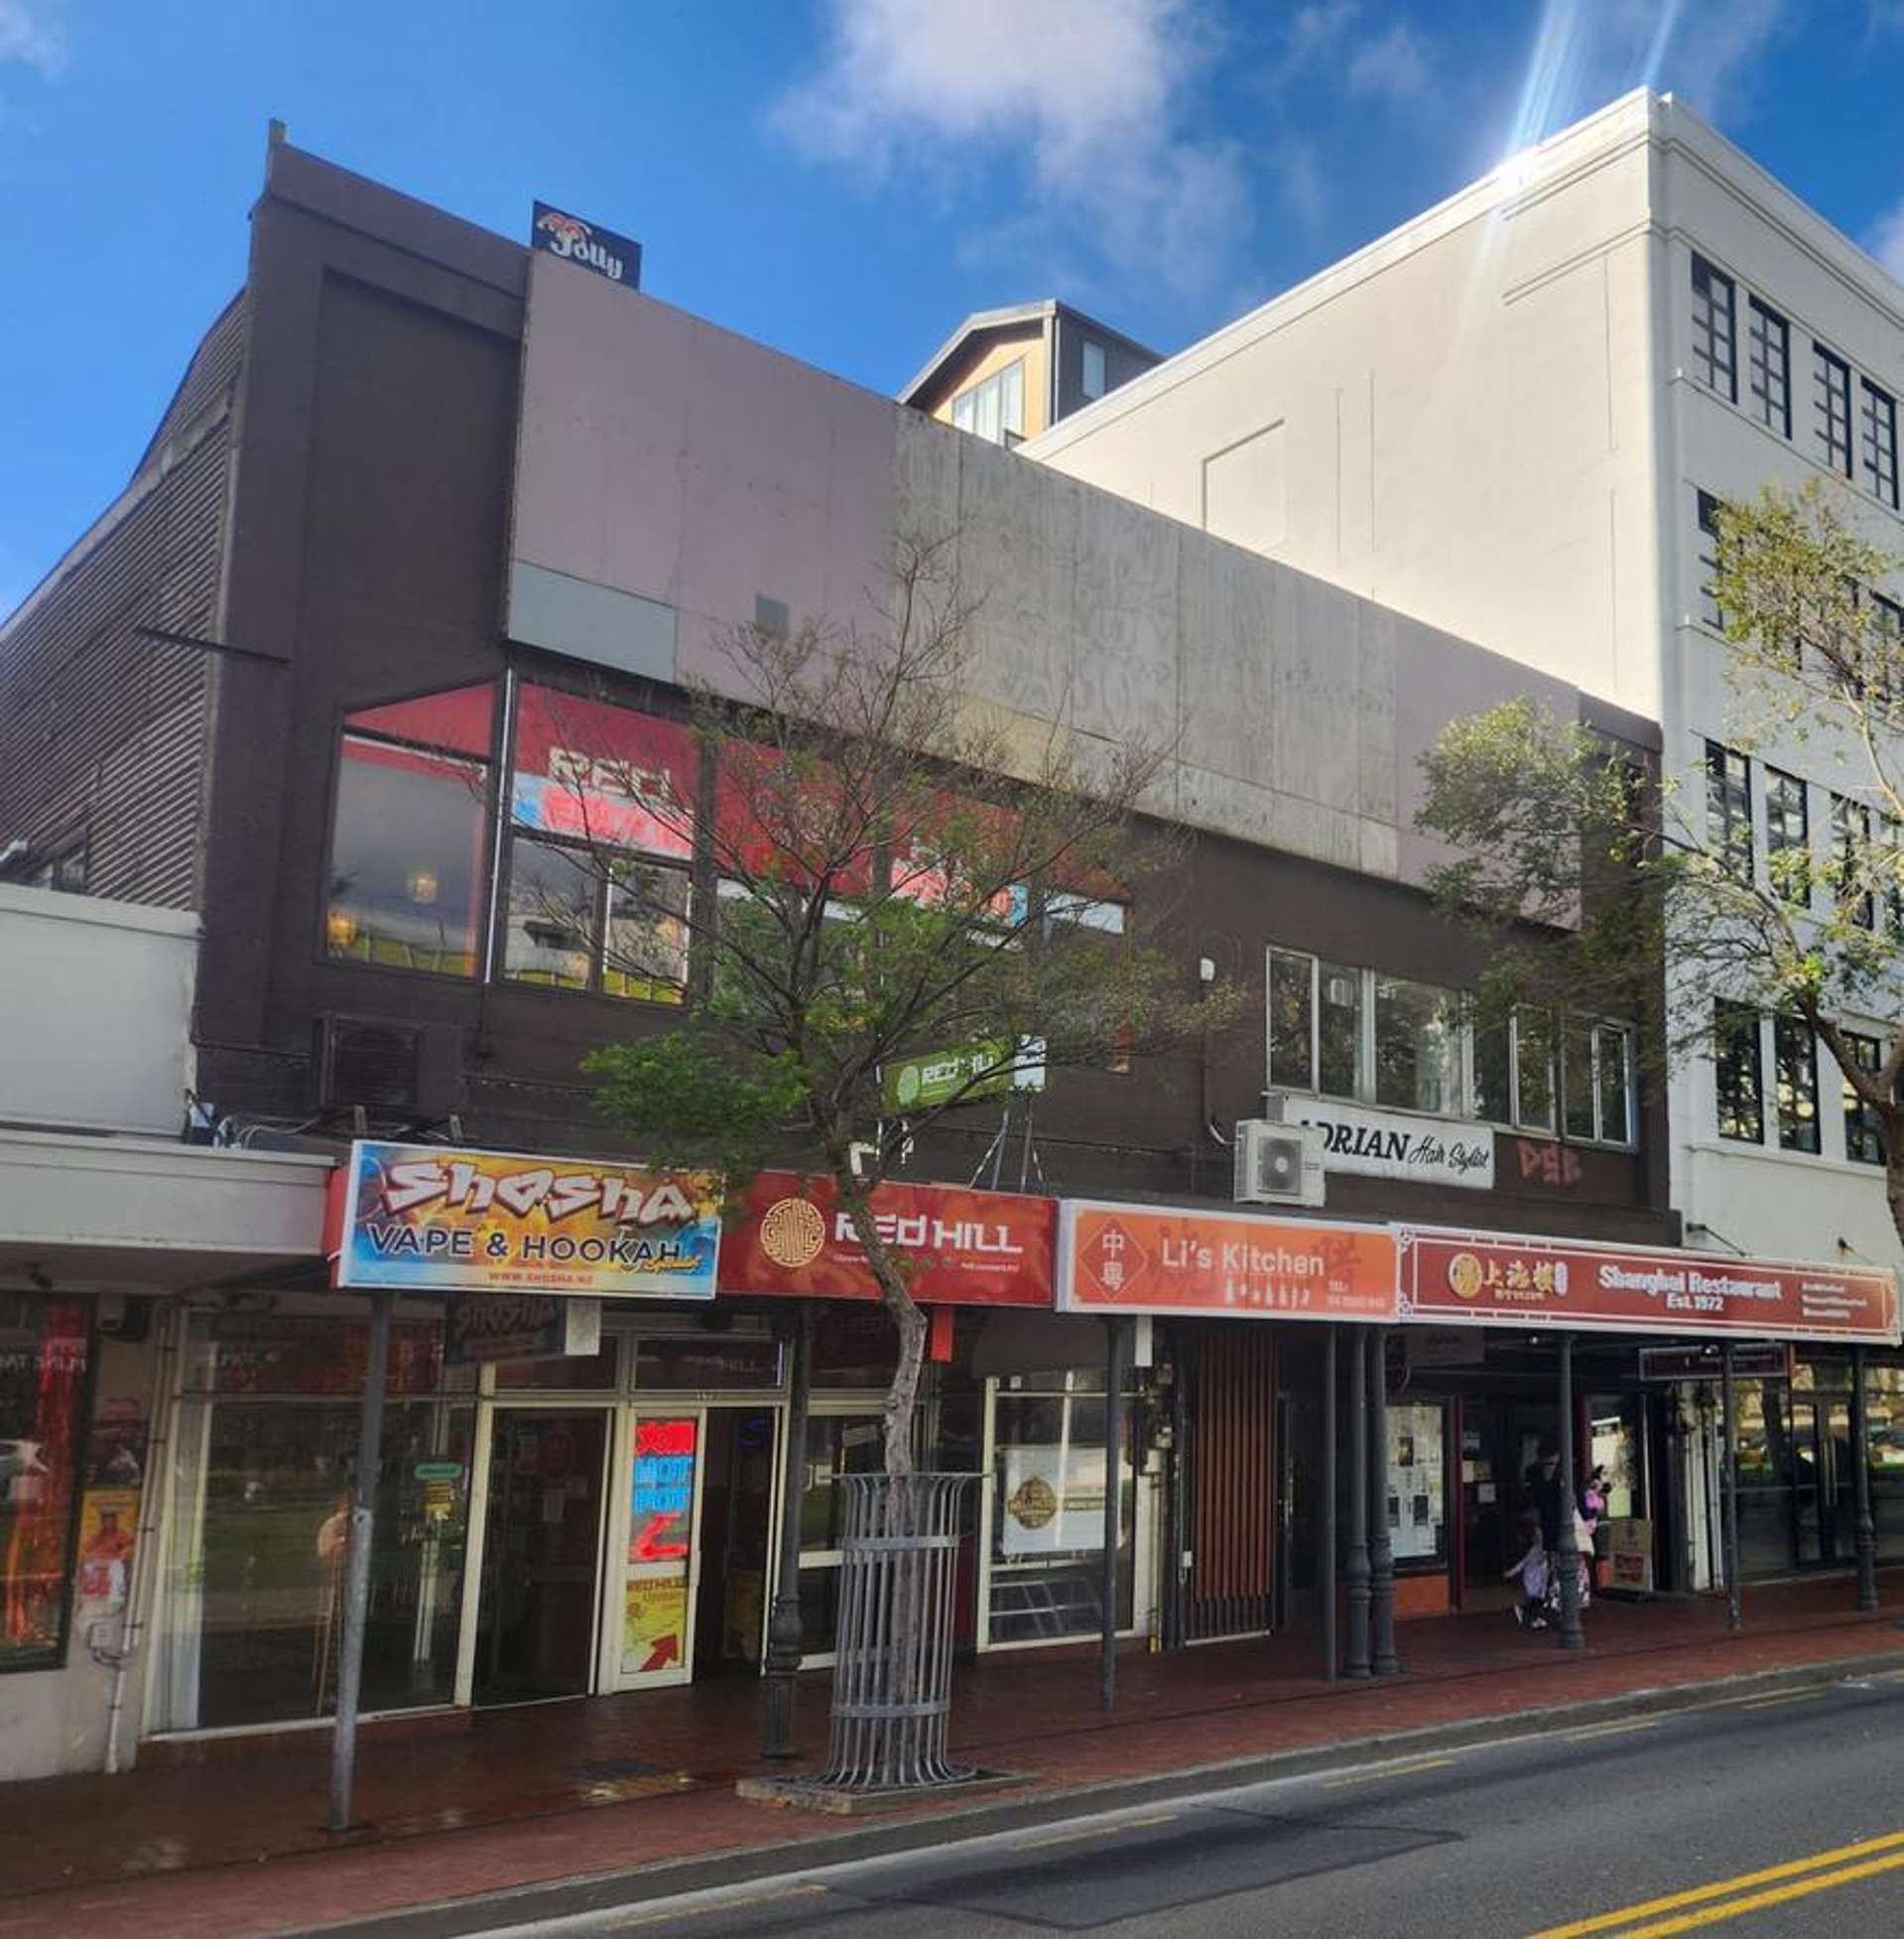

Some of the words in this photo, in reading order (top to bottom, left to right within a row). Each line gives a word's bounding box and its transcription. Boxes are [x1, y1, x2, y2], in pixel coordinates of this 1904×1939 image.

[1301, 1119, 1410, 1160] DRIAN
[1408, 1135, 1446, 1164] Hair
[368, 1226, 472, 1255] VAPE
[486, 1233, 508, 1256] &
[524, 1236, 680, 1263] HOOKAH
[933, 1220, 1023, 1253] HILL
[1162, 1238, 1211, 1268] Li's
[1222, 1242, 1324, 1276] Kitchen
[1599, 1265, 1685, 1295] Shanghai
[1689, 1270, 1782, 1300] Restaurant
[1695, 1295, 1723, 1311] 1972
